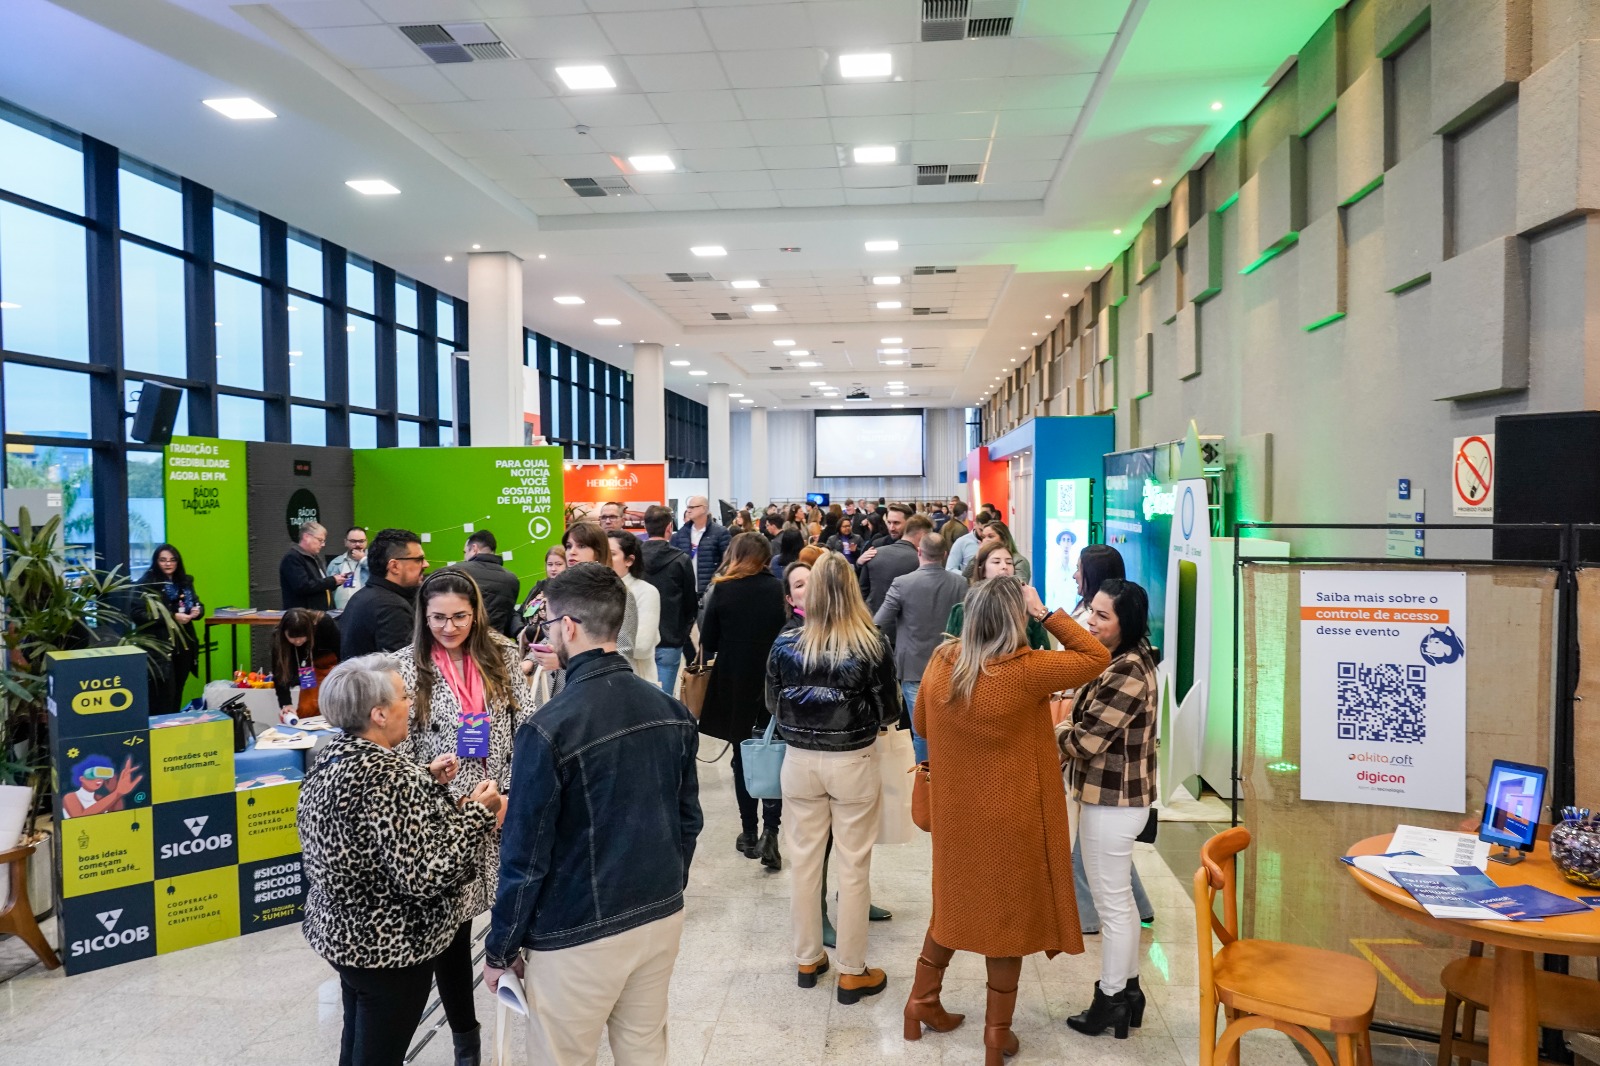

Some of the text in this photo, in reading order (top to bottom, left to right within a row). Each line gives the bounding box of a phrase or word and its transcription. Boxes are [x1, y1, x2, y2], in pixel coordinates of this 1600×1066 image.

[170, 443, 219, 455] TRADIÇÃO E
[169, 457, 230, 468] CREDIBILIDADE
[495, 459, 550, 468] PARA QUAL
[170, 471, 227, 481] AGORA EM FM.
[510, 468, 550, 477] NOTÍCIA
[520, 475, 548, 486] VOCÊ
[194, 485, 218, 498] RÁDIO
[502, 487, 551, 495] GOSTARIA
[181, 499, 220, 509] TAQUARA
[497, 496, 550, 504] DE DAR UM
[298, 507, 317, 516] RÁDIO
[522, 505, 551, 513] PLAY?
[1316, 592, 1438, 604] Saiba mais sobre o
[1316, 610, 1439, 621] controle de acesso
[1316, 625, 1400, 637] desse evento
[79, 676, 121, 690] VOCÊ
[81, 696, 102, 707] ON
[163, 750, 218, 763] conexões que
[1356, 770, 1405, 784] digicon
[248, 806, 295, 820] COOPERAÇÃO
[248, 817, 282, 828] CONEXÃO
[248, 823, 297, 836] CRIATIVIDADE
[161, 833, 232, 859] SICOOB
[79, 848, 127, 862] boas ideias
[79, 858, 122, 871] começam
[253, 862, 301, 879] #SICOOB
[79, 872, 98, 880] com
[254, 873, 302, 891] #SICOOB
[254, 885, 302, 904] #SICOOB
[167, 893, 218, 909] COOPERAÇÃO
[168, 905, 204, 917] CONEXÃO
[262, 908, 295, 921] SUMMIT
[168, 910, 221, 925] CRIATIVIDADE
[71, 925, 150, 957] SICOOB
